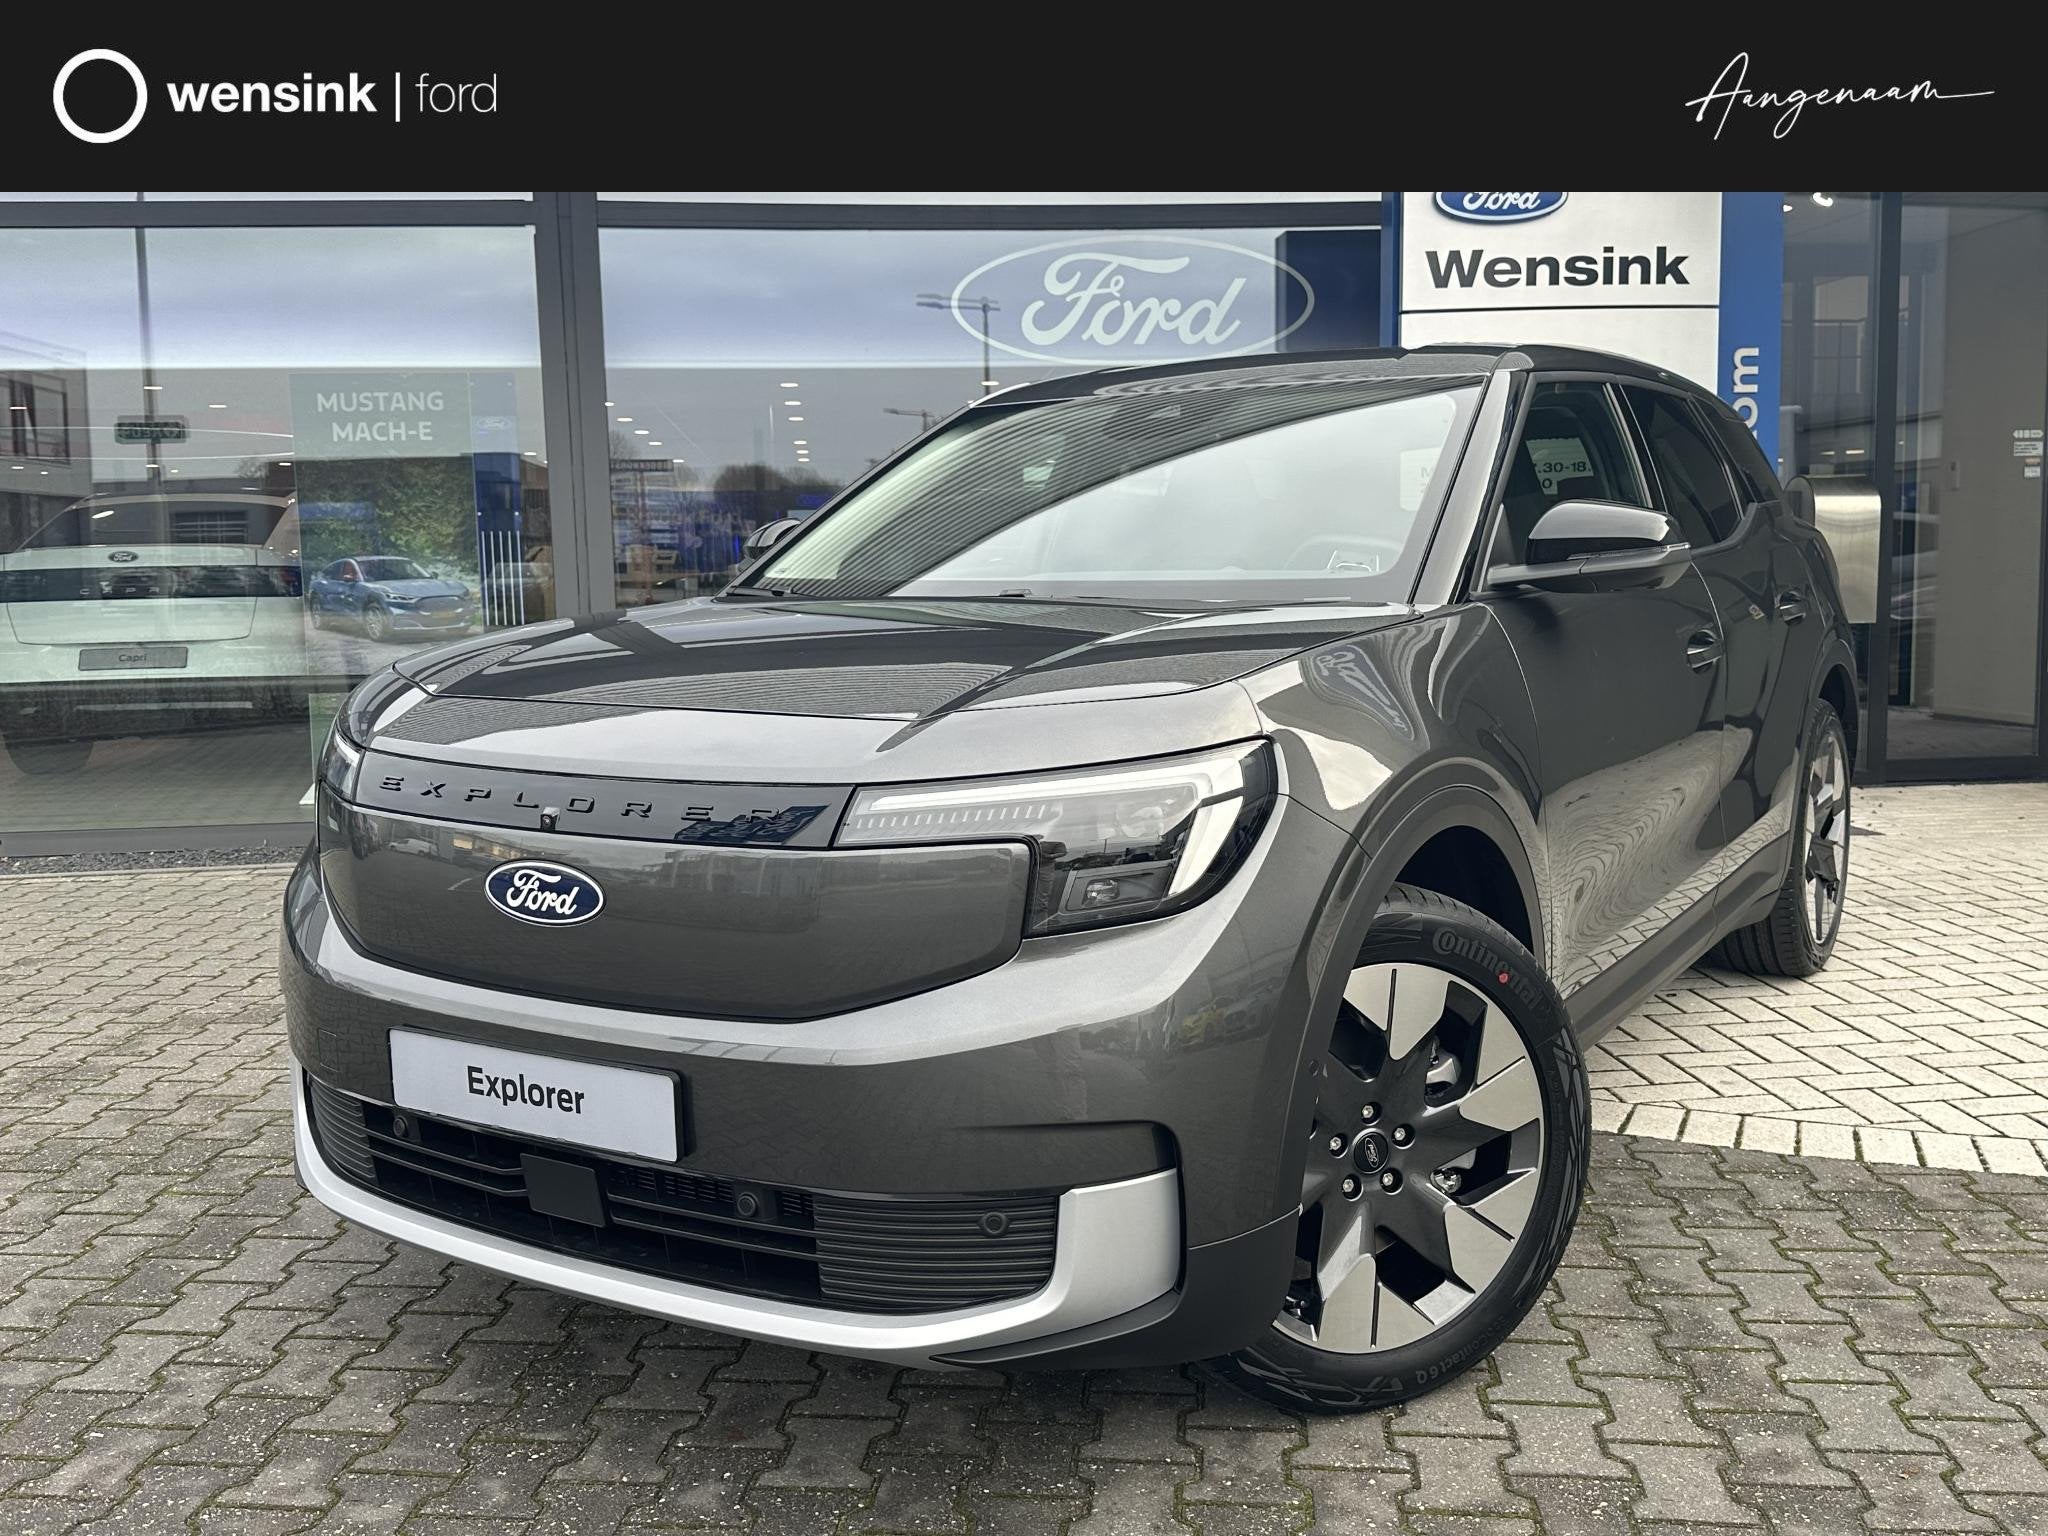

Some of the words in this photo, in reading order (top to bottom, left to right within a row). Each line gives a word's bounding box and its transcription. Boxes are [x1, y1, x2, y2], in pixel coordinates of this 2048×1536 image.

[1425, 246, 1691, 289] Wensink
[1021, 252, 1247, 346] Ford
[316, 391, 445, 412] MUSTANG
[332, 421, 434, 442] MACH-E
[118, 653, 148, 664] Capri
[379, 776, 784, 823] EXPLORER
[506, 869, 580, 916] Ford
[467, 1065, 585, 1115] Explorer
